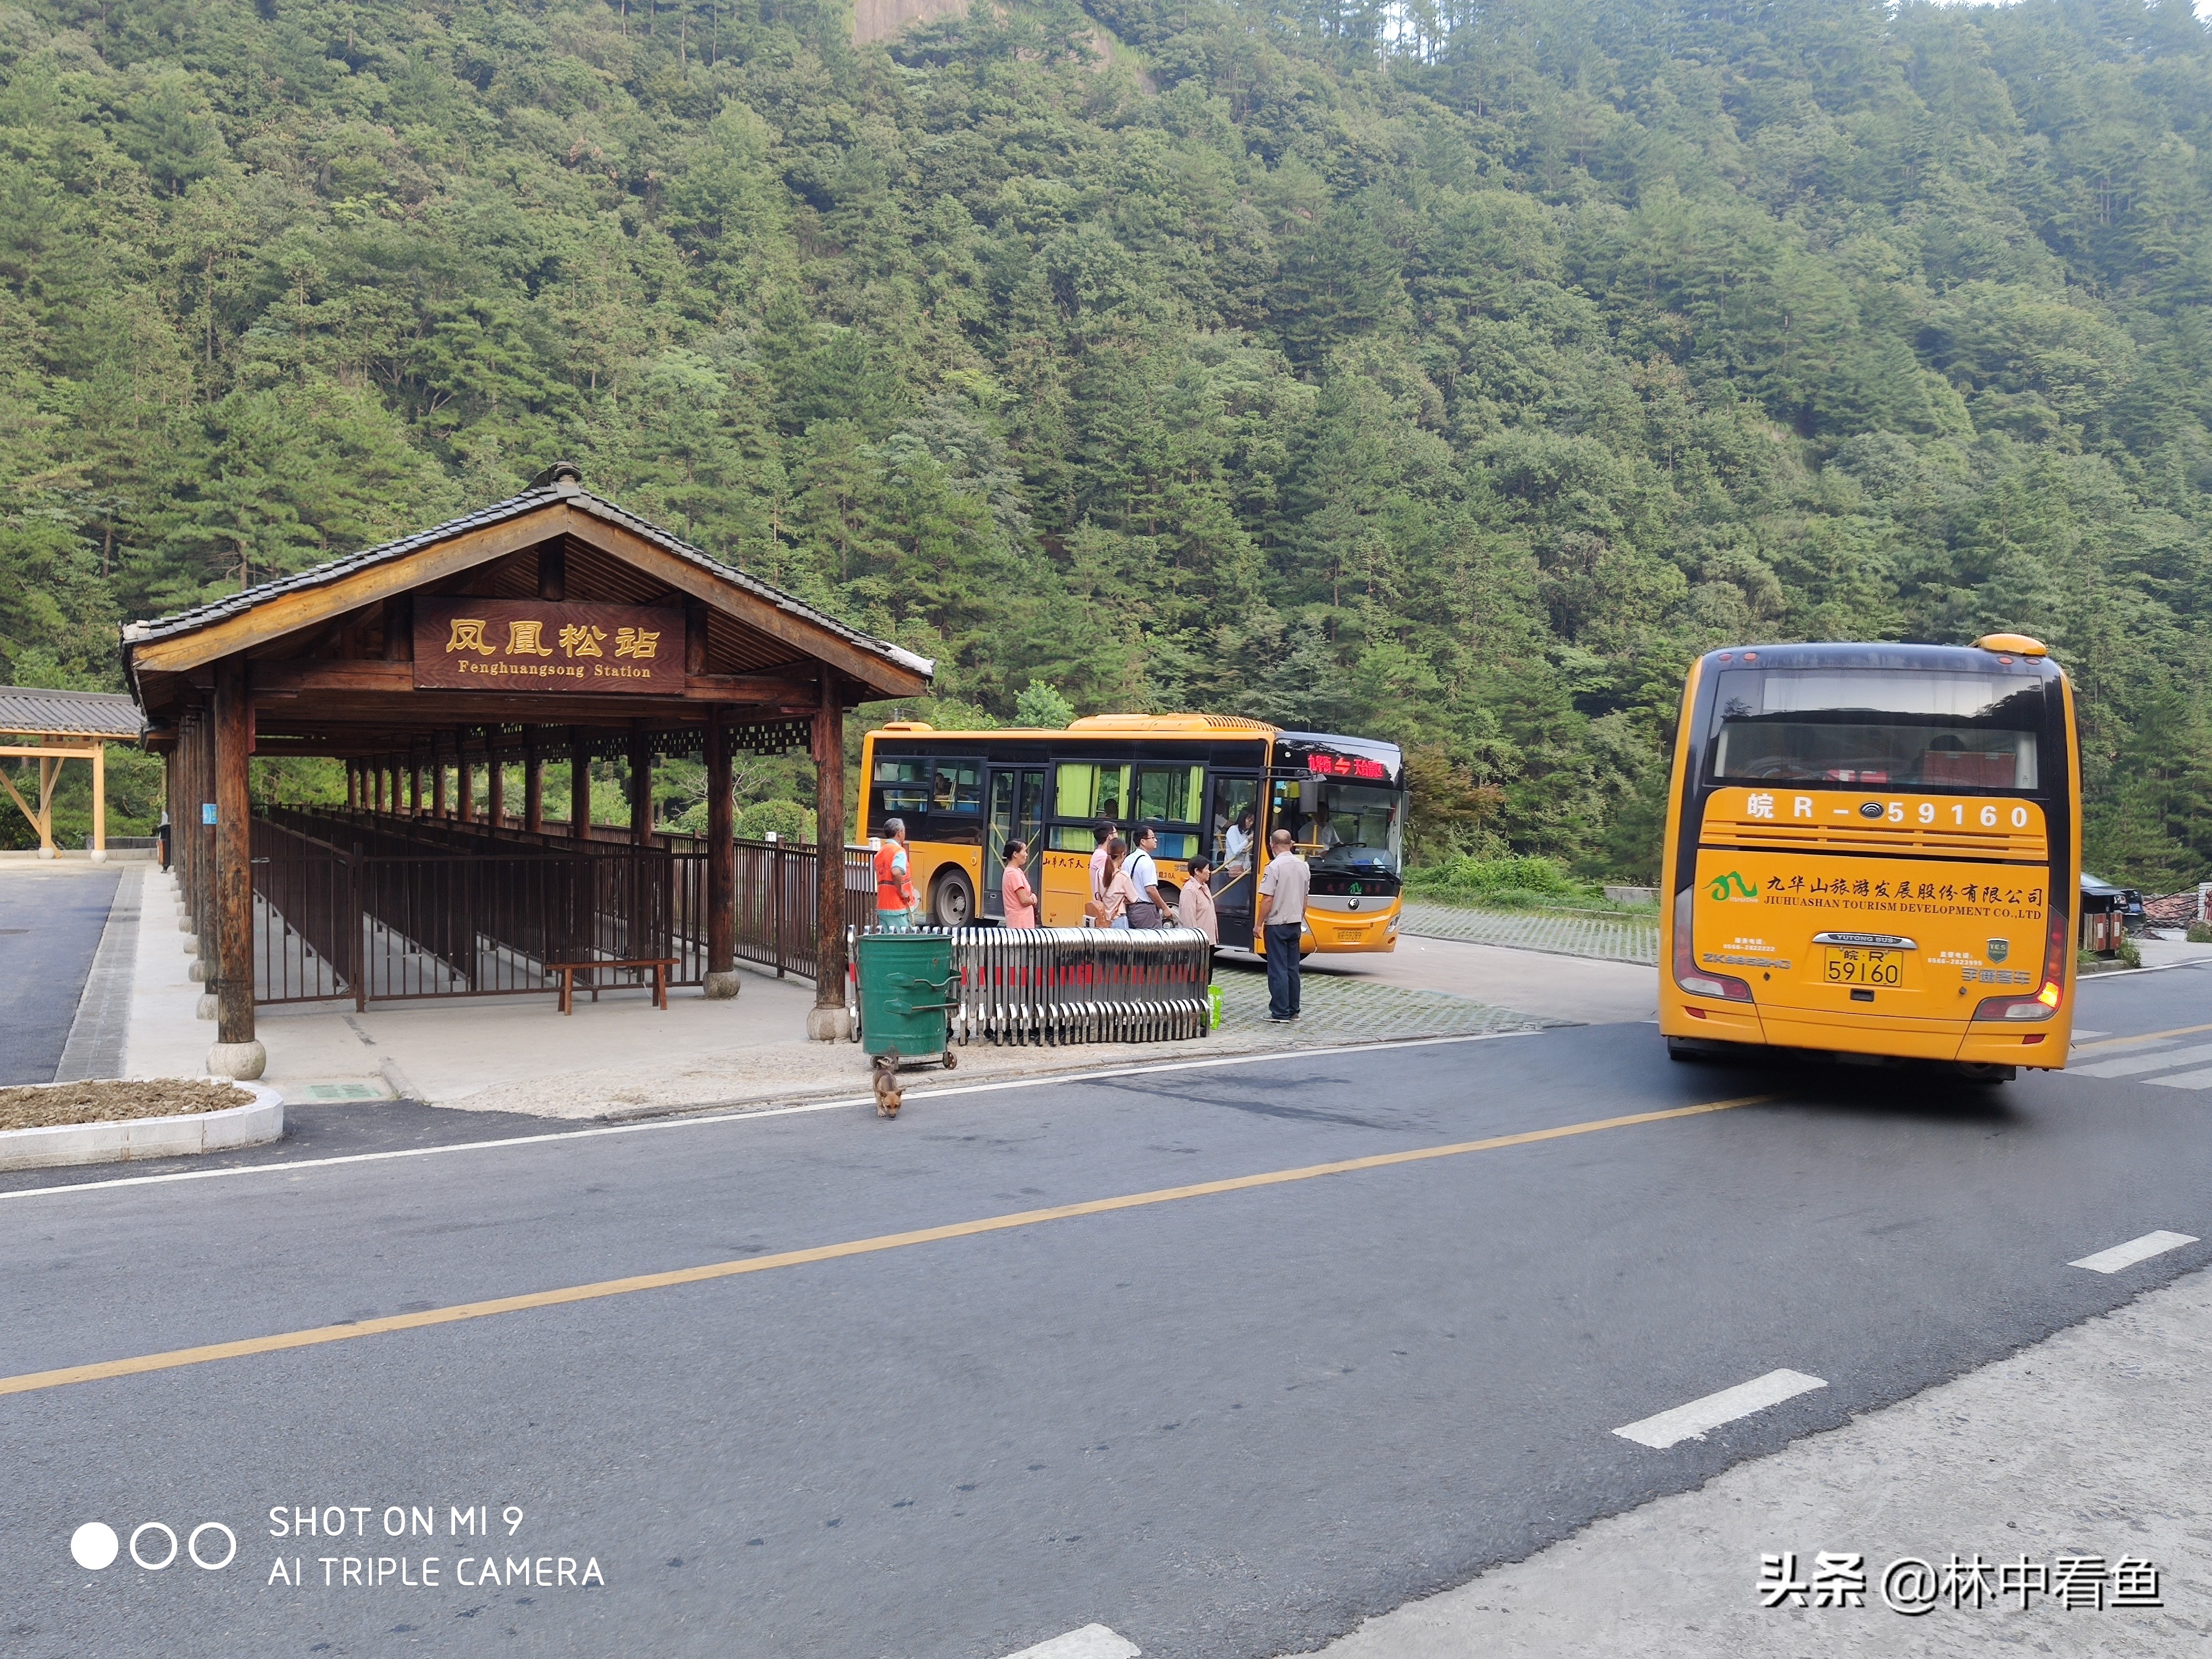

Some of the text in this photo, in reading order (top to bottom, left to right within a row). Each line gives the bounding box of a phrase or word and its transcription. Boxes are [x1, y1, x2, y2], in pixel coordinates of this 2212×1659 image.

[446, 618, 661, 659] 凤凰松站
[458, 660, 651, 679] Fenghuangsong Station
[1766, 875, 2043, 907] 九华山旅游发展股份有限公司
[1764, 895, 2042, 920] JIUHUASHAN TOURISM DEVELOPMENT CO.,LTD
[1837, 934, 1874, 942] YUTONG
[1927, 957, 1983, 966] 0566-2823995
[1828, 961, 1898, 983] 59160
[1961, 966, 2031, 985] 宇通客车
